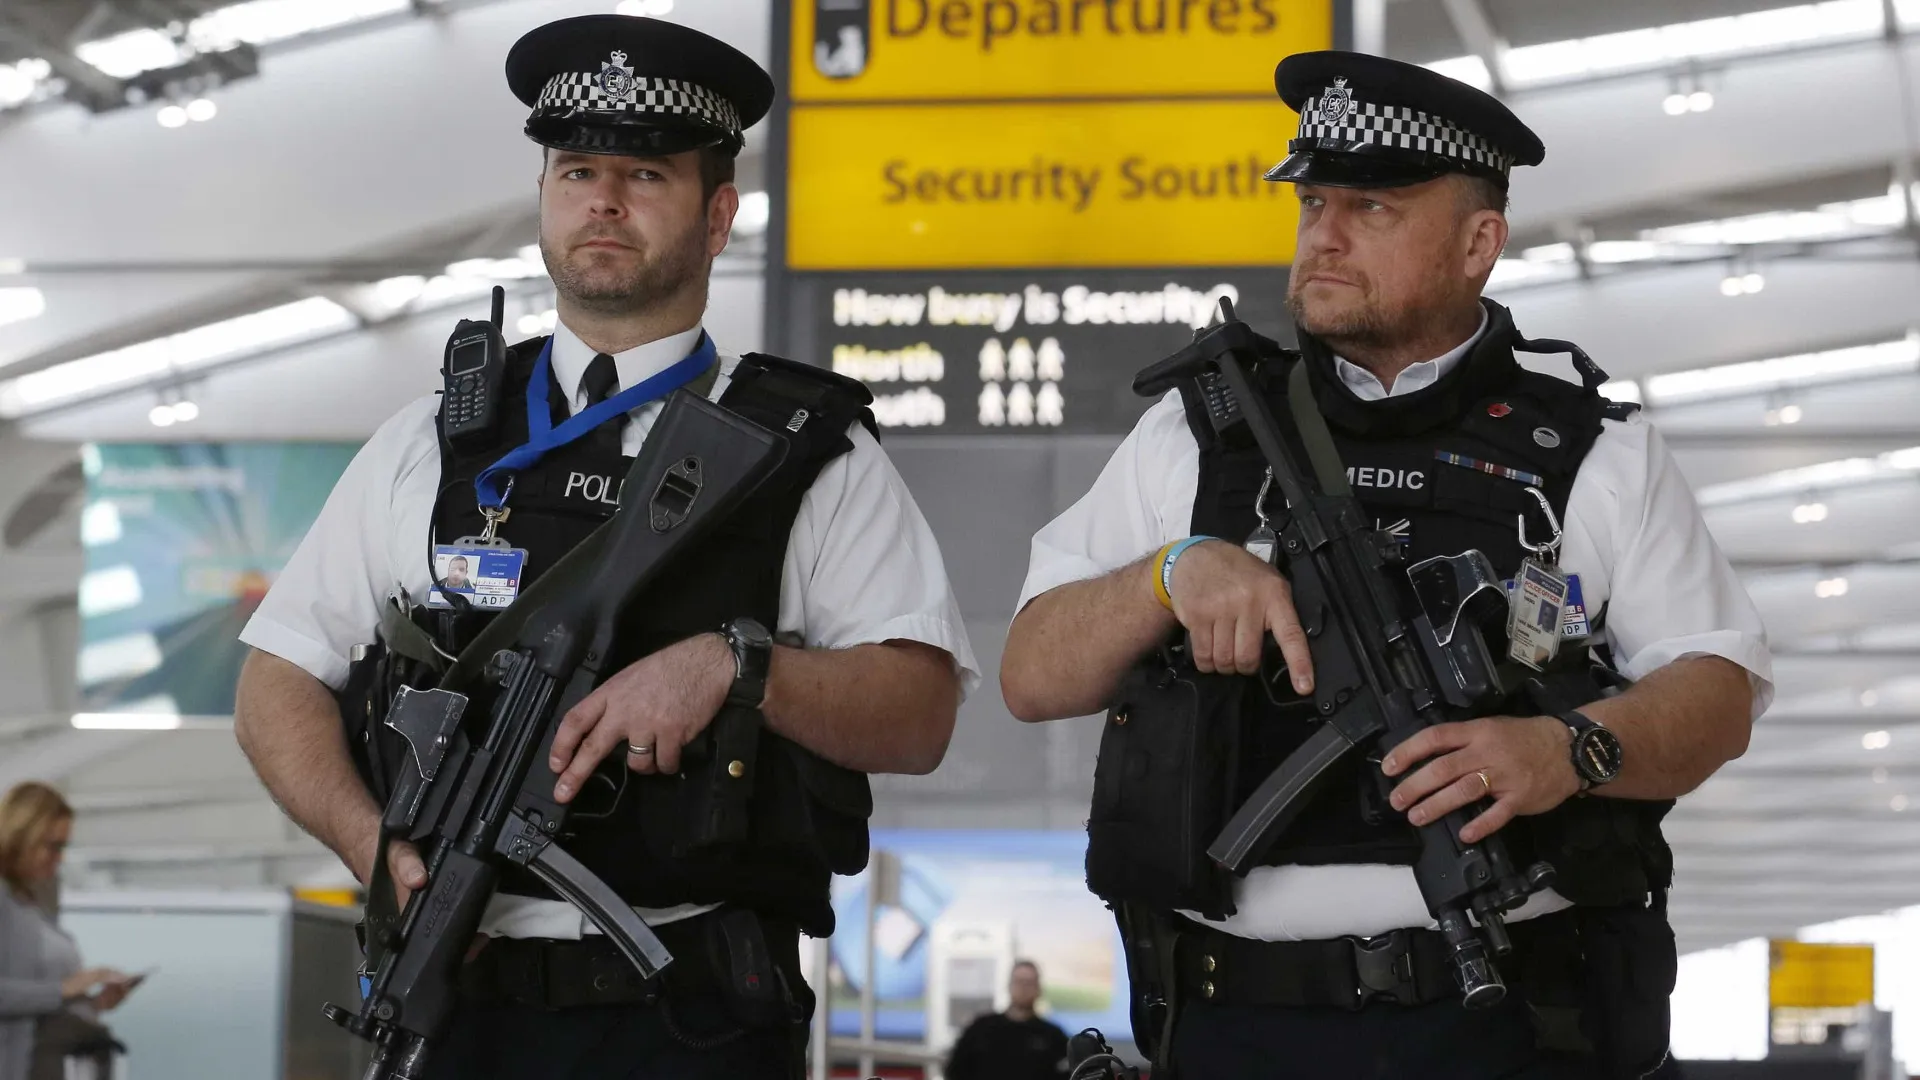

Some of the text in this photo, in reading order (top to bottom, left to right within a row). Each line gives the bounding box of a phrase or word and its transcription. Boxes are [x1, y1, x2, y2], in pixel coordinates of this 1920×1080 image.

[886, 0, 1277, 52] Departures
[882, 154, 1280, 210] Security South
[833, 282, 1239, 332] How busy is Security?
[832, 343, 945, 382] North
